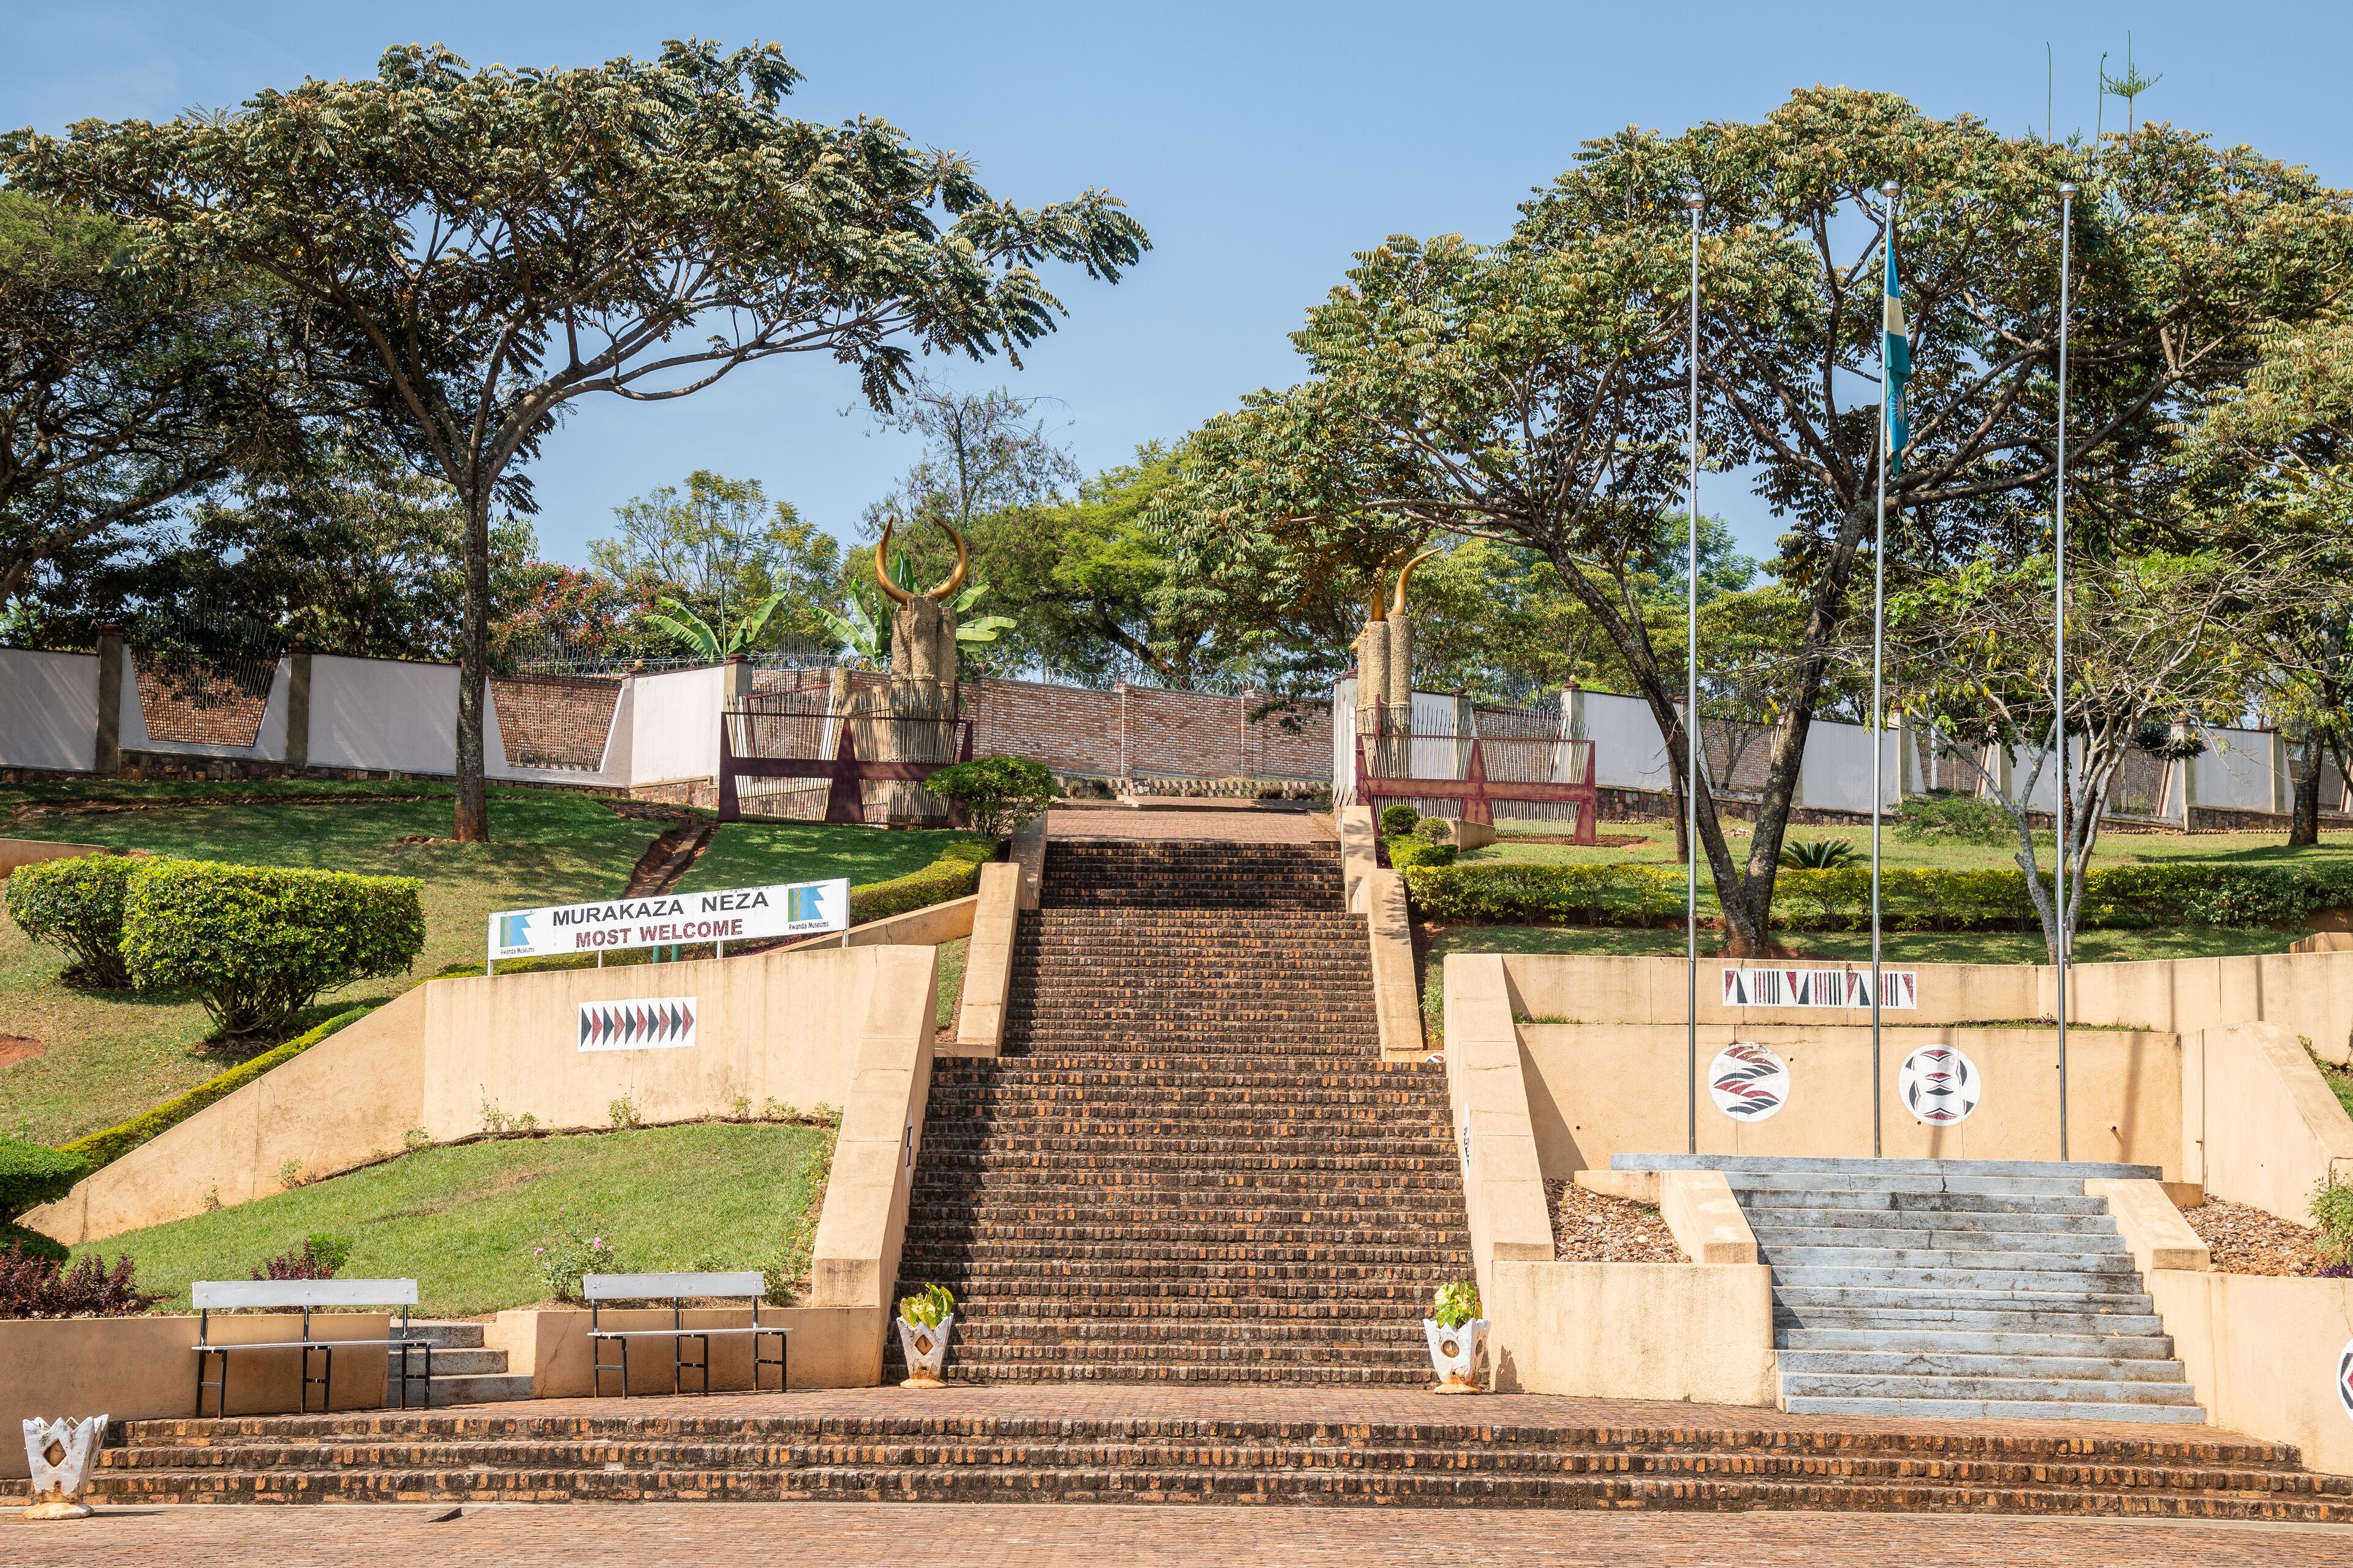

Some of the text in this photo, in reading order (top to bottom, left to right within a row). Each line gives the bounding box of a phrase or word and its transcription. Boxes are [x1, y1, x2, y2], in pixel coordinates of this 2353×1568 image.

[553, 892, 768, 926] MURAKAZA NEZA
[576, 919, 743, 948] MOST WELCOME
